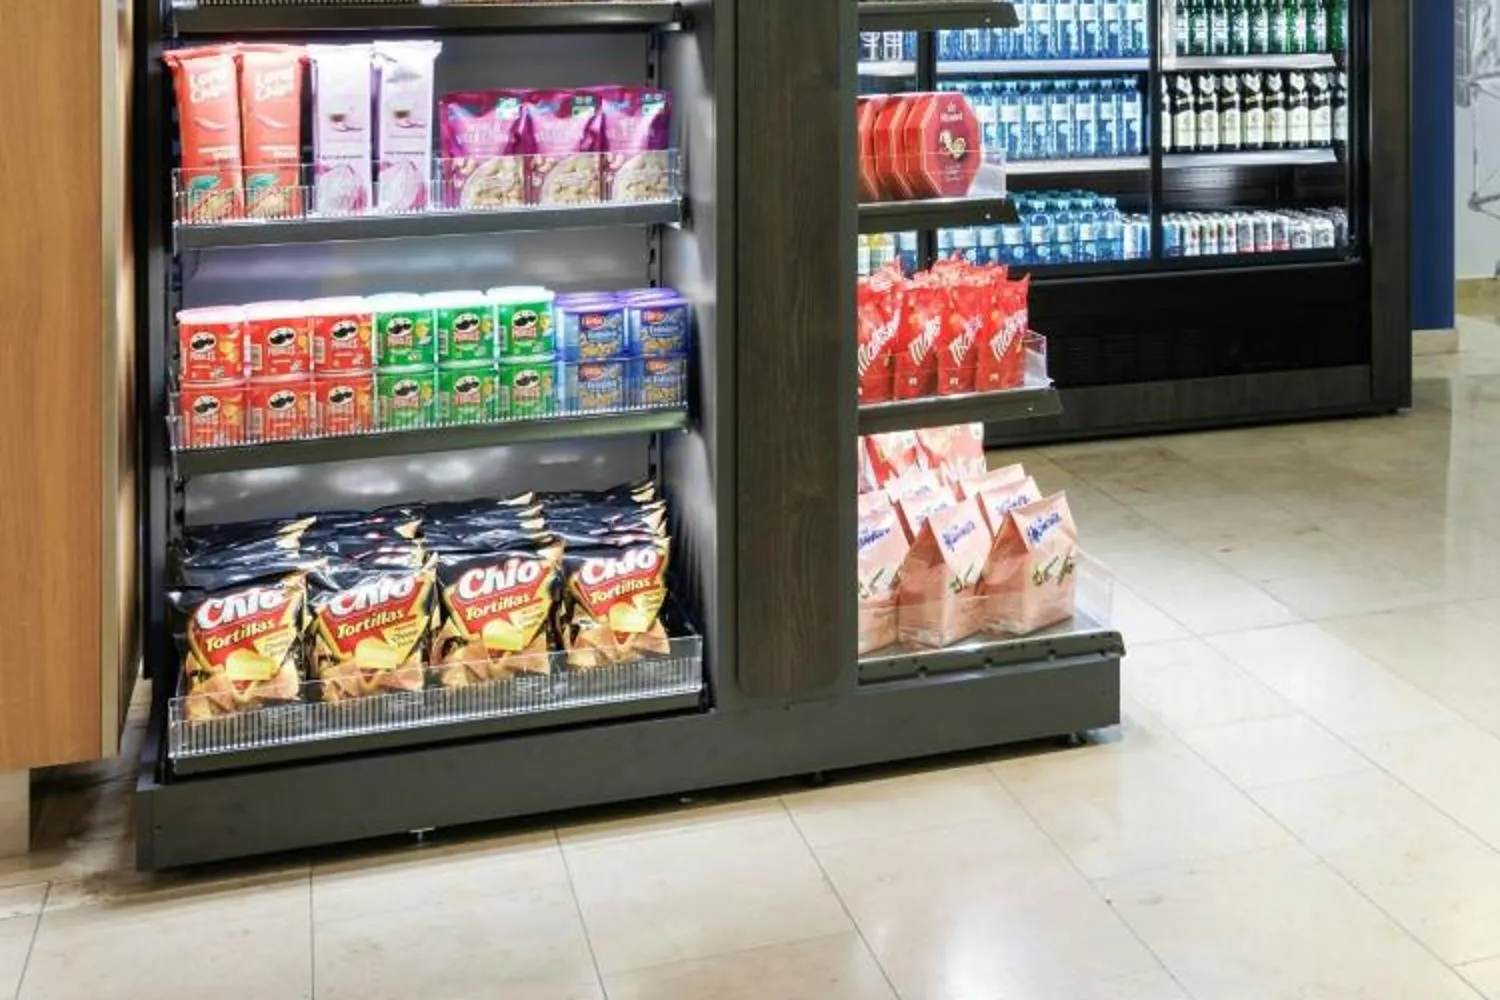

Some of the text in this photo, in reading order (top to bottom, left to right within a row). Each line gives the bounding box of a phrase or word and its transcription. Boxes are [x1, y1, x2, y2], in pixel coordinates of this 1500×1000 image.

[458, 557, 542, 600] Chio
[589, 577, 653, 605] Tortillas
[464, 592, 532, 621] Tortillas
[205, 618, 275, 652] Tortillas
[336, 608, 405, 640] Tortillas
